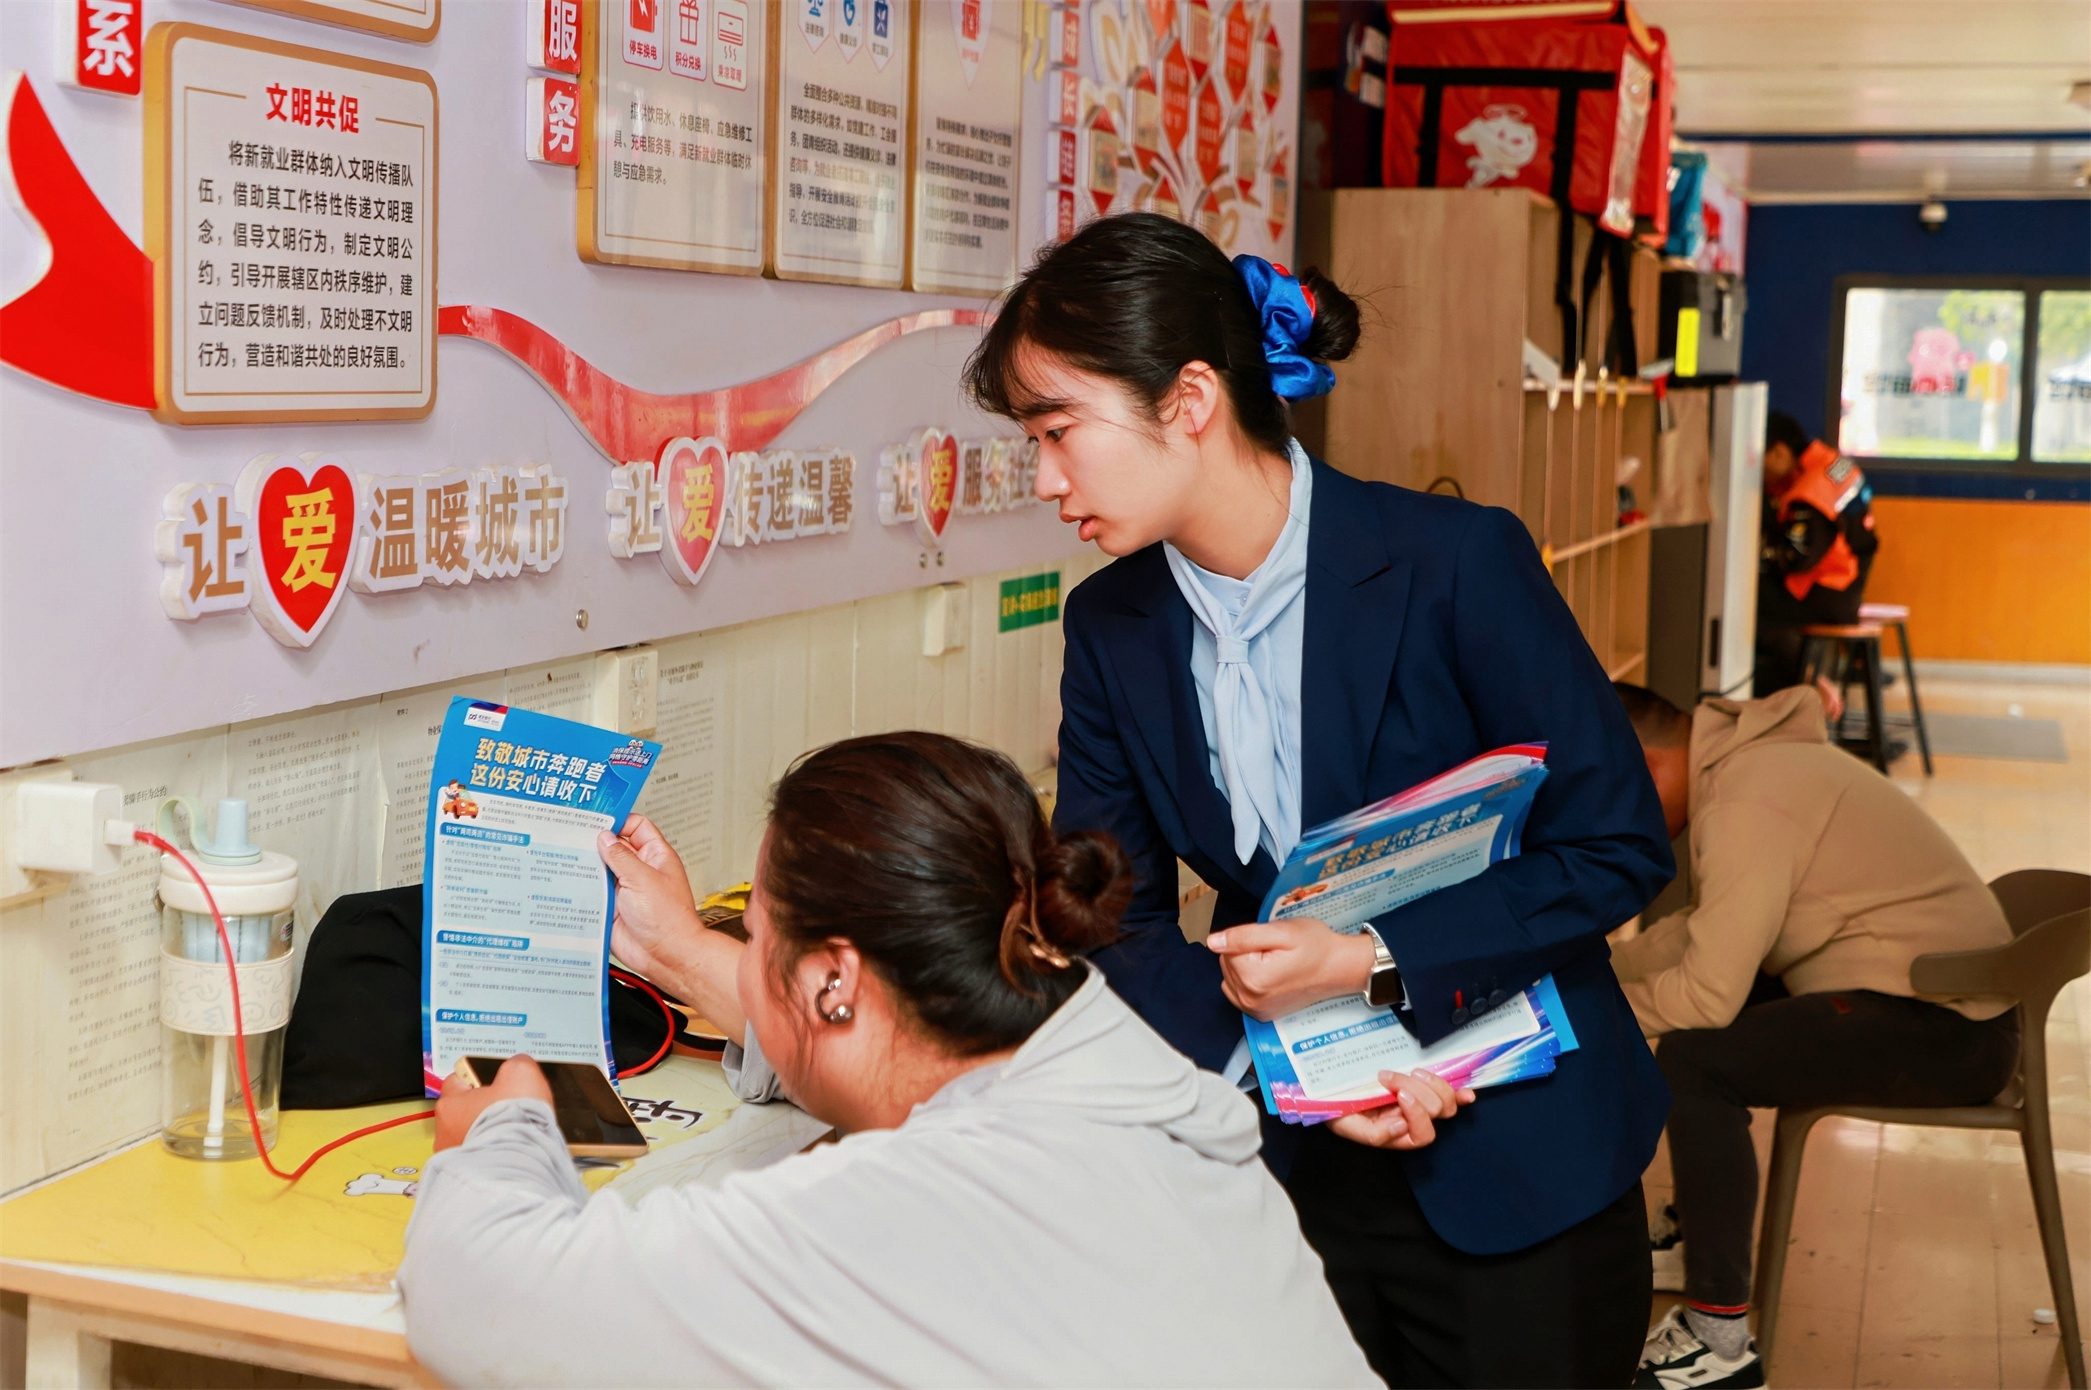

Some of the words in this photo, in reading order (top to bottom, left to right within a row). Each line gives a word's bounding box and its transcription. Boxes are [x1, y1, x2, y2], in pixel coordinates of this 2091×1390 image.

[83, 0, 135, 78] 系
[629, 39, 658, 60] 停车换电
[675, 51, 702, 71] 积分兑换
[265, 83, 360, 134] 文明共促
[228, 140, 414, 188] 将新就业群体纳入文明传播队
[198, 177, 414, 224] 伍，借助其工作特性传递文明理
[198, 218, 413, 261] 念，倡导文明行为，制定文明公
[198, 259, 413, 297] 约，引导开展辖区内秩序维护，建
[198, 301, 413, 333] 立问题反馈机制，及时处理不文明
[198, 341, 406, 369] 行为，营造和谐共处的良好氛围。
[624, 453, 855, 547] 让爱传递温馨
[182, 474, 566, 605] 让爱温暖城市
[474, 737, 608, 783] 致敬城市奔跑者
[469, 763, 598, 804] 这份安心请收下
